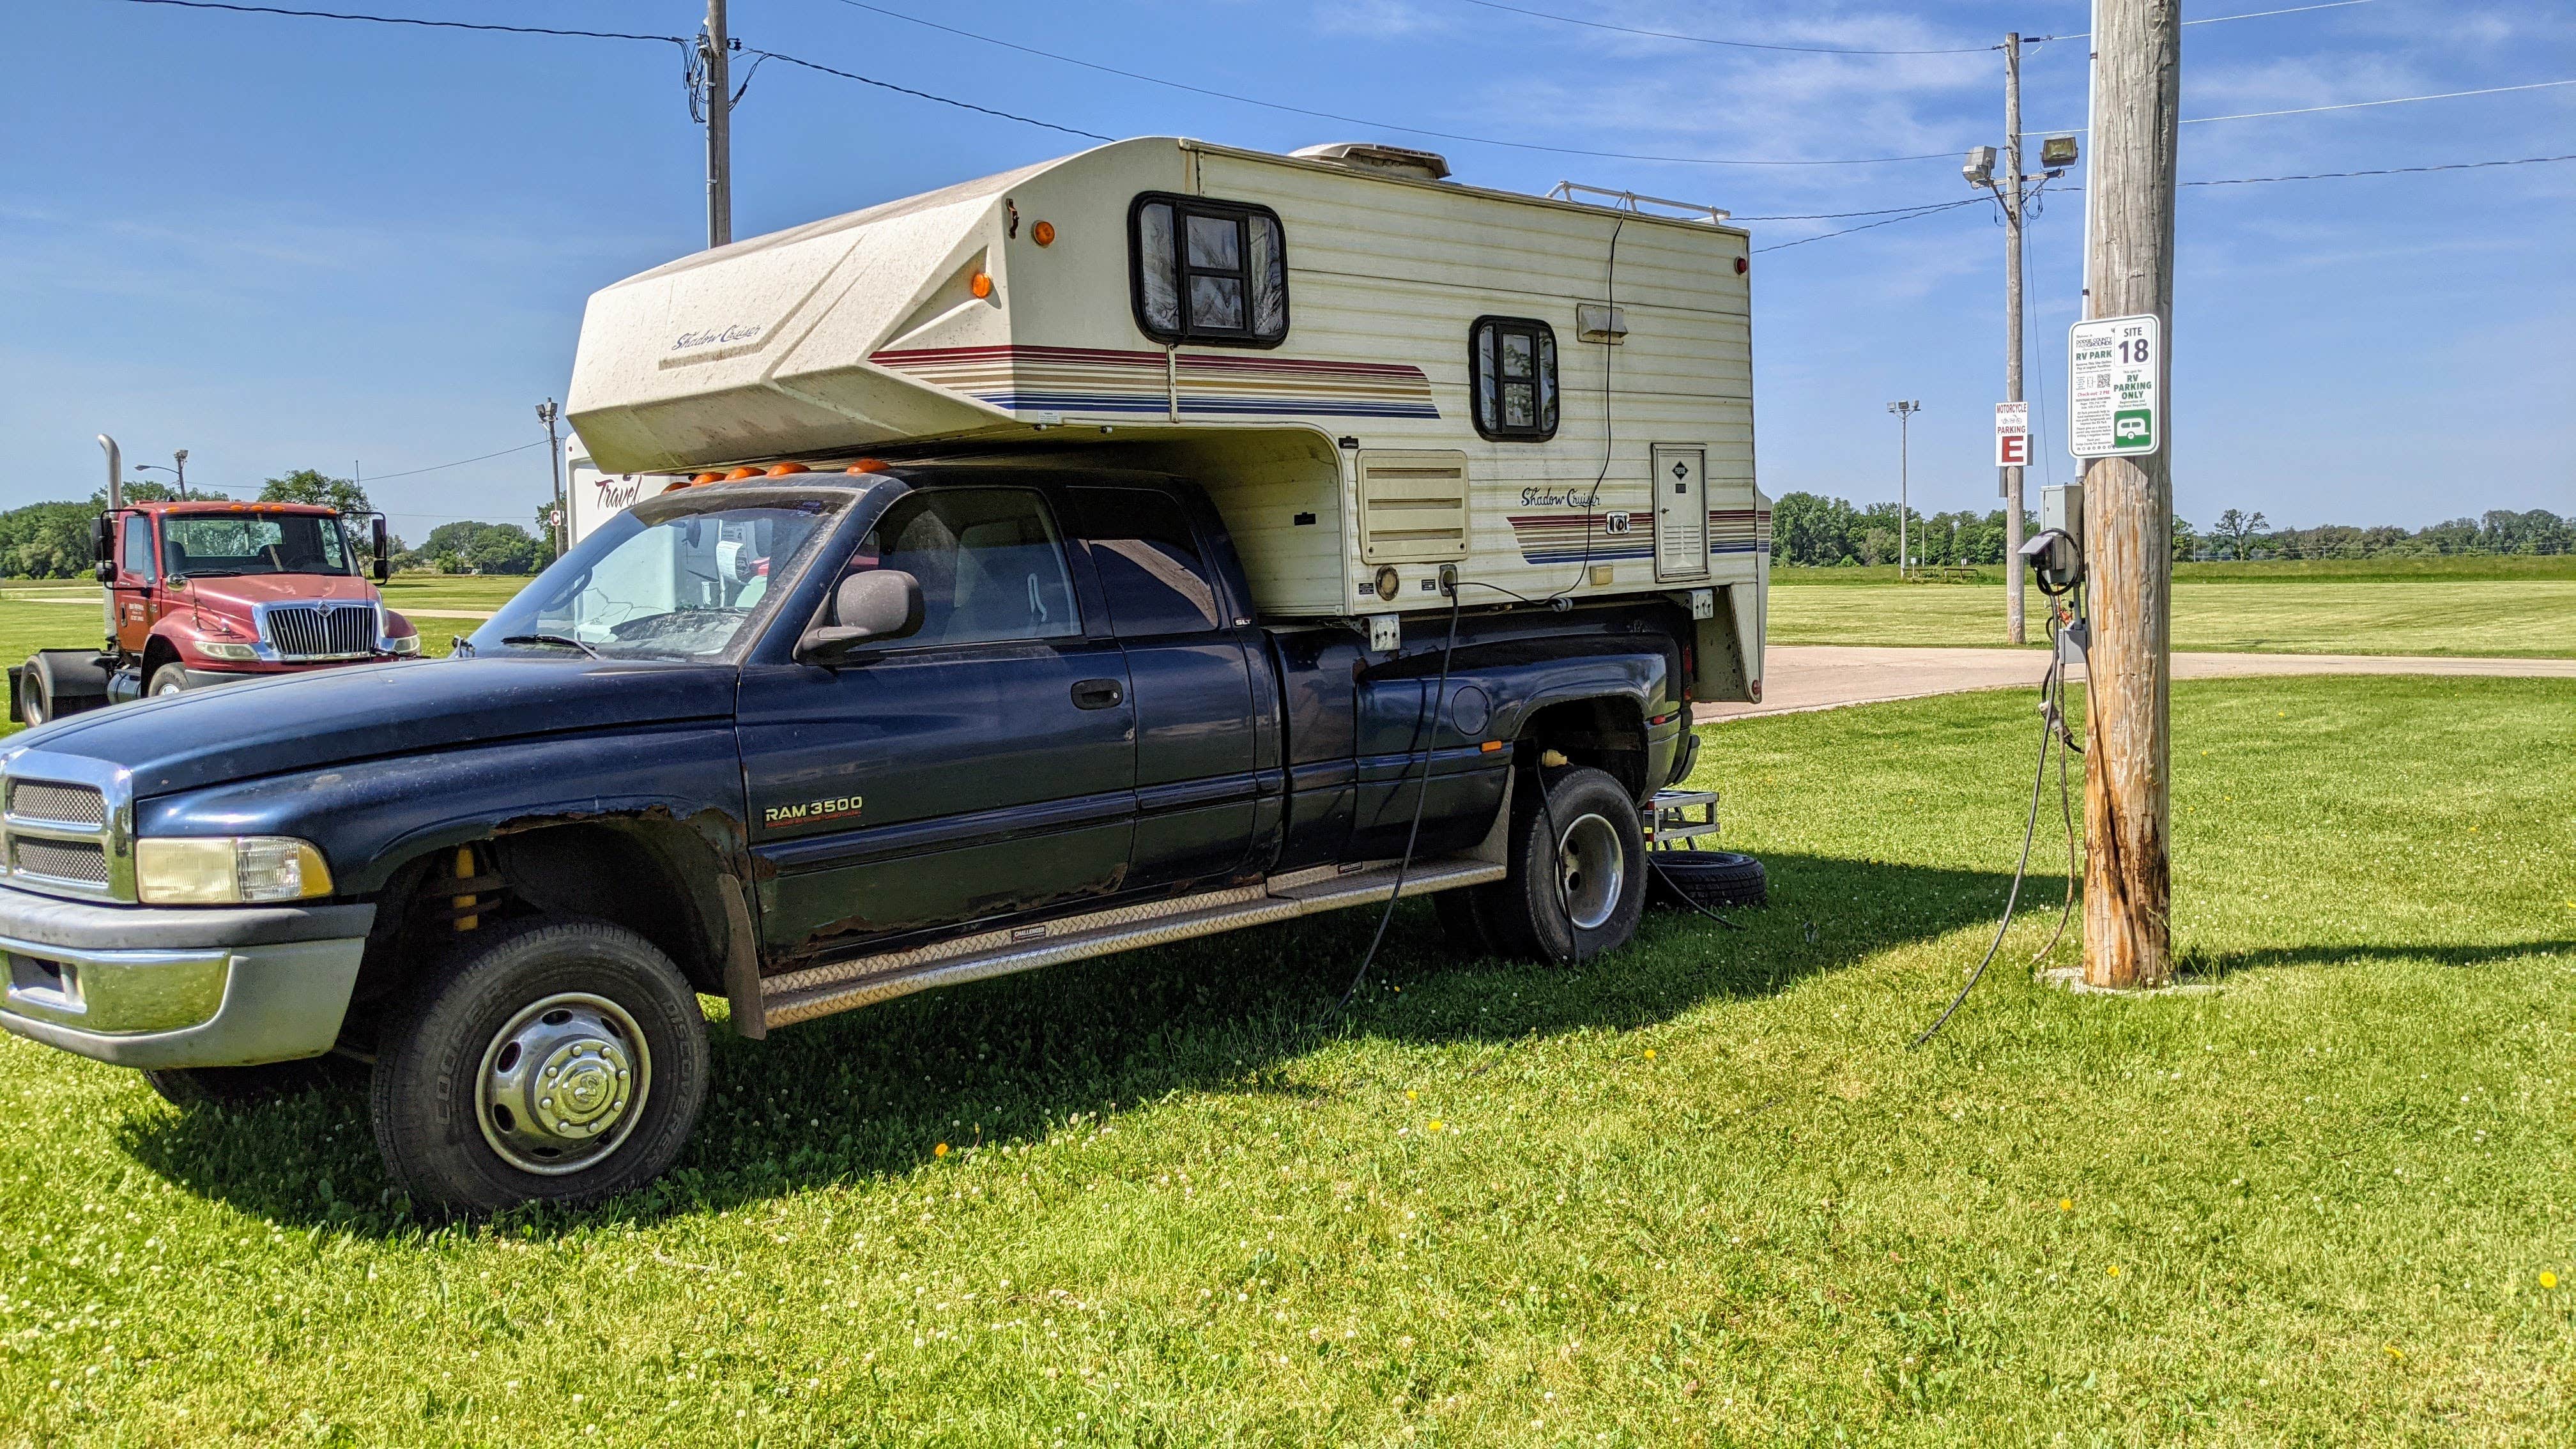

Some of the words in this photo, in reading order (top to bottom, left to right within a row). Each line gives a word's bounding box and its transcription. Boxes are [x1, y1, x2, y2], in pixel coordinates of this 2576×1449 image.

[671, 329, 721, 350] Shadow
[720, 325, 761, 342] Cruiser
[2124, 326, 2142, 337] SITE
[2076, 352, 2087, 361] RV
[2089, 349, 2112, 360] PARK
[2118, 339, 2149, 364] 18
[2126, 374, 2138, 383] RV
[2113, 381, 2152, 392] PARKING
[2121, 390, 2144, 400] ONLY
[1997, 404, 2027, 413] MOTORCYCLE
[1997, 425, 2026, 434] PARKING
[2002, 436, 2023, 463] E
[594, 475, 643, 510] Travel
[1521, 487, 1565, 507] Shadow
[551, 512, 559, 525] C
[765, 804, 807, 822] RAM
[809, 796, 862, 815] 3500
